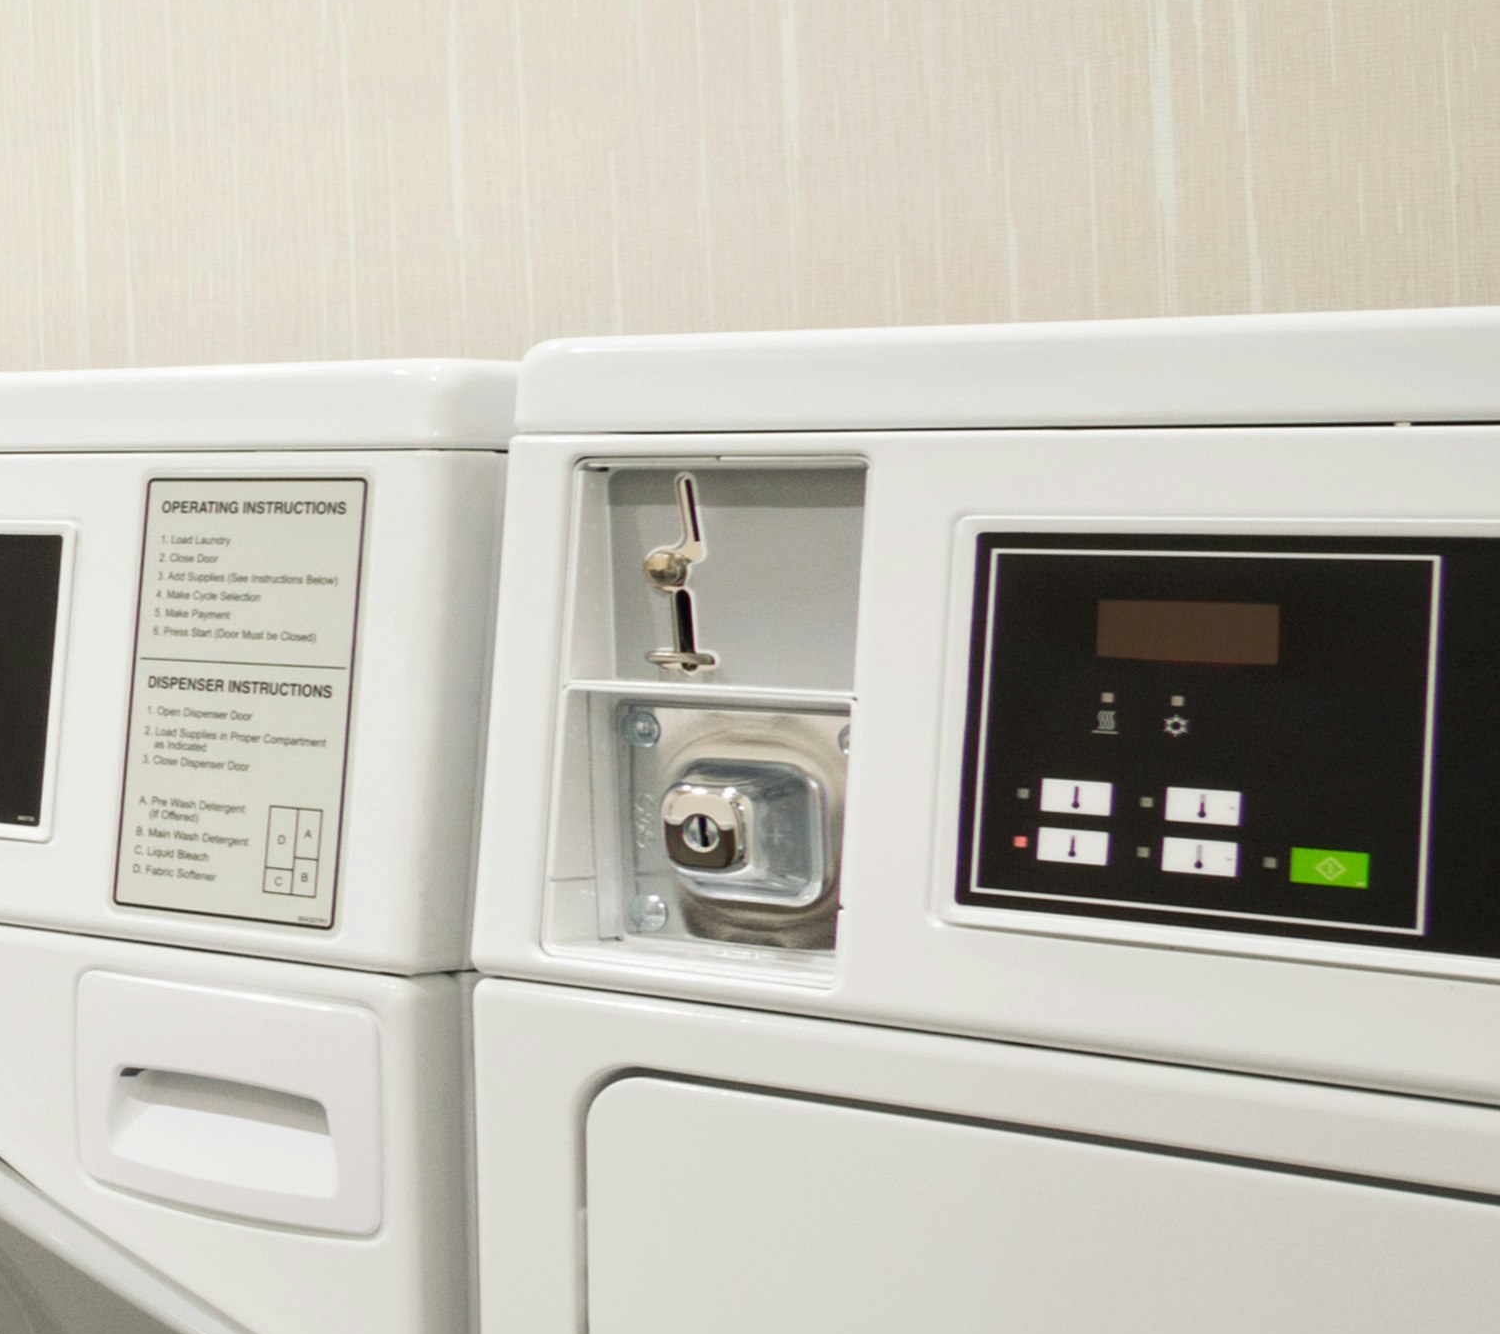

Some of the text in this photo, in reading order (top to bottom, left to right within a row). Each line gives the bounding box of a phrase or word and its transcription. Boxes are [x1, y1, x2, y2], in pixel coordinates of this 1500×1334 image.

[161, 501, 347, 515] OPERATING INSTRUCTIONS
[171, 535, 193, 545] Load
[195, 536, 231, 547] Laundry
[170, 553, 194, 563] Close
[197, 554, 218, 564] Door
[167, 591, 190, 600] Make
[193, 591, 217, 602] Cycle
[220, 592, 261, 602] Selection
[165, 609, 188, 618] Make
[191, 609, 230, 621] Payment
[148, 676, 332, 699] DISPENSER INSTRUCTIONS
[157, 706, 181, 718] Open
[183, 708, 228, 721] Dispenser
[230, 710, 252, 721] Door
[155, 727, 177, 738] Load
[180, 728, 217, 741] Supplies
[220, 731, 227, 740] in
[230, 731, 261, 744] Proper
[263, 734, 326, 748] Compartment
[153, 755, 178, 766] Close
[181, 757, 225, 770] Dispenser
[227, 760, 249, 772] Door
[151, 796, 167, 807] Pre
[170, 797, 196, 809] Wash
[199, 799, 245, 814] Detergent
[148, 827, 170, 839] Main
[173, 829, 199, 842] Wash
[202, 832, 249, 847] Detergent
[277, 835, 286, 845] D
[303, 829, 312, 839] A
[147, 846, 175, 859] Liquid
[177, 849, 209, 862] Bleach
[145, 865, 174, 878] Fabric
[176, 868, 216, 882] Softener
[301, 873, 309, 882] B
[274, 876, 283, 886] C
